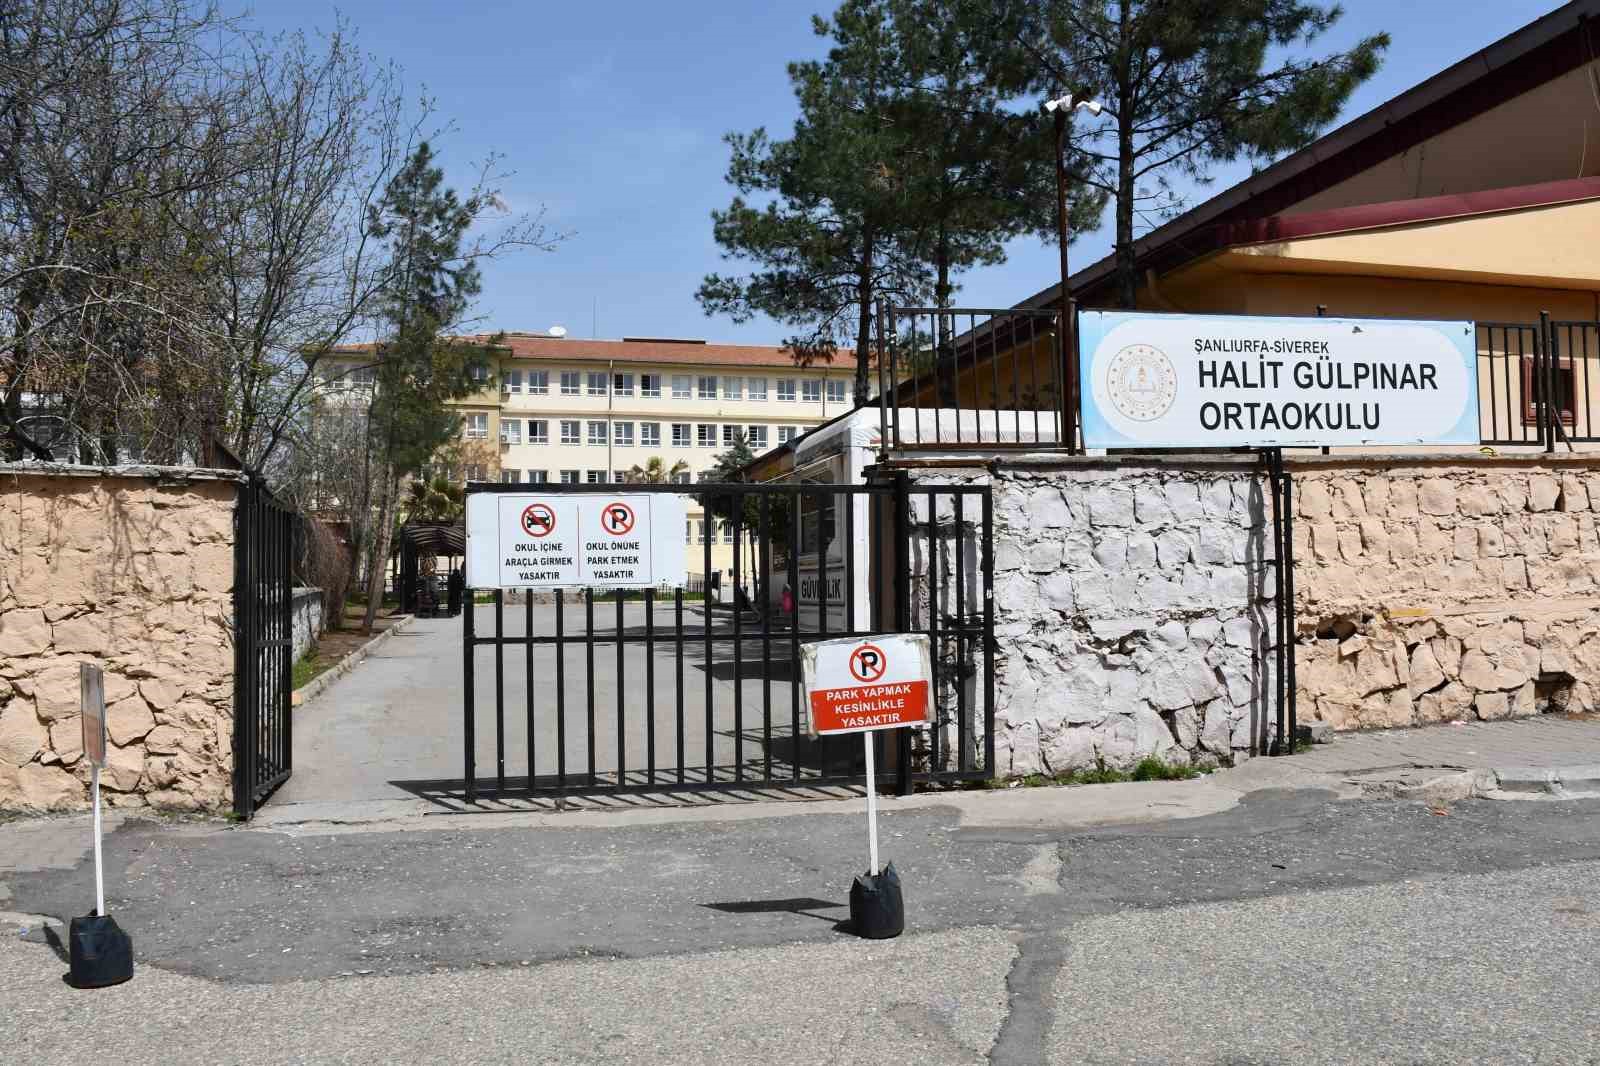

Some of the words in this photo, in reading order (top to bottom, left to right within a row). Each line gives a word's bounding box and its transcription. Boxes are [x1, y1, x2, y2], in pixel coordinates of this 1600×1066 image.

[1194, 338, 1329, 354] ŞANLIURFA-SİVEREK
[1199, 354, 1283, 388] HALİT
[1293, 355, 1438, 389] GÜLPINAR
[1200, 402, 1380, 430] ORTAOKULU
[515, 543, 538, 552] OKUL
[586, 542, 608, 551] OKUL
[505, 558, 538, 567] ARAÇLA
[540, 556, 573, 566] GİRMEK
[587, 556, 608, 565] PARK
[611, 555, 639, 565] ETMEK
[519, 571, 560, 580] YASAKTIR
[593, 570, 634, 579] YASAKTIR
[826, 689, 860, 701] PARK
[862, 684, 912, 698] YAPMAK
[835, 698, 905, 714] KESİNLİKLE
[841, 712, 900, 728] YASAKTIR
